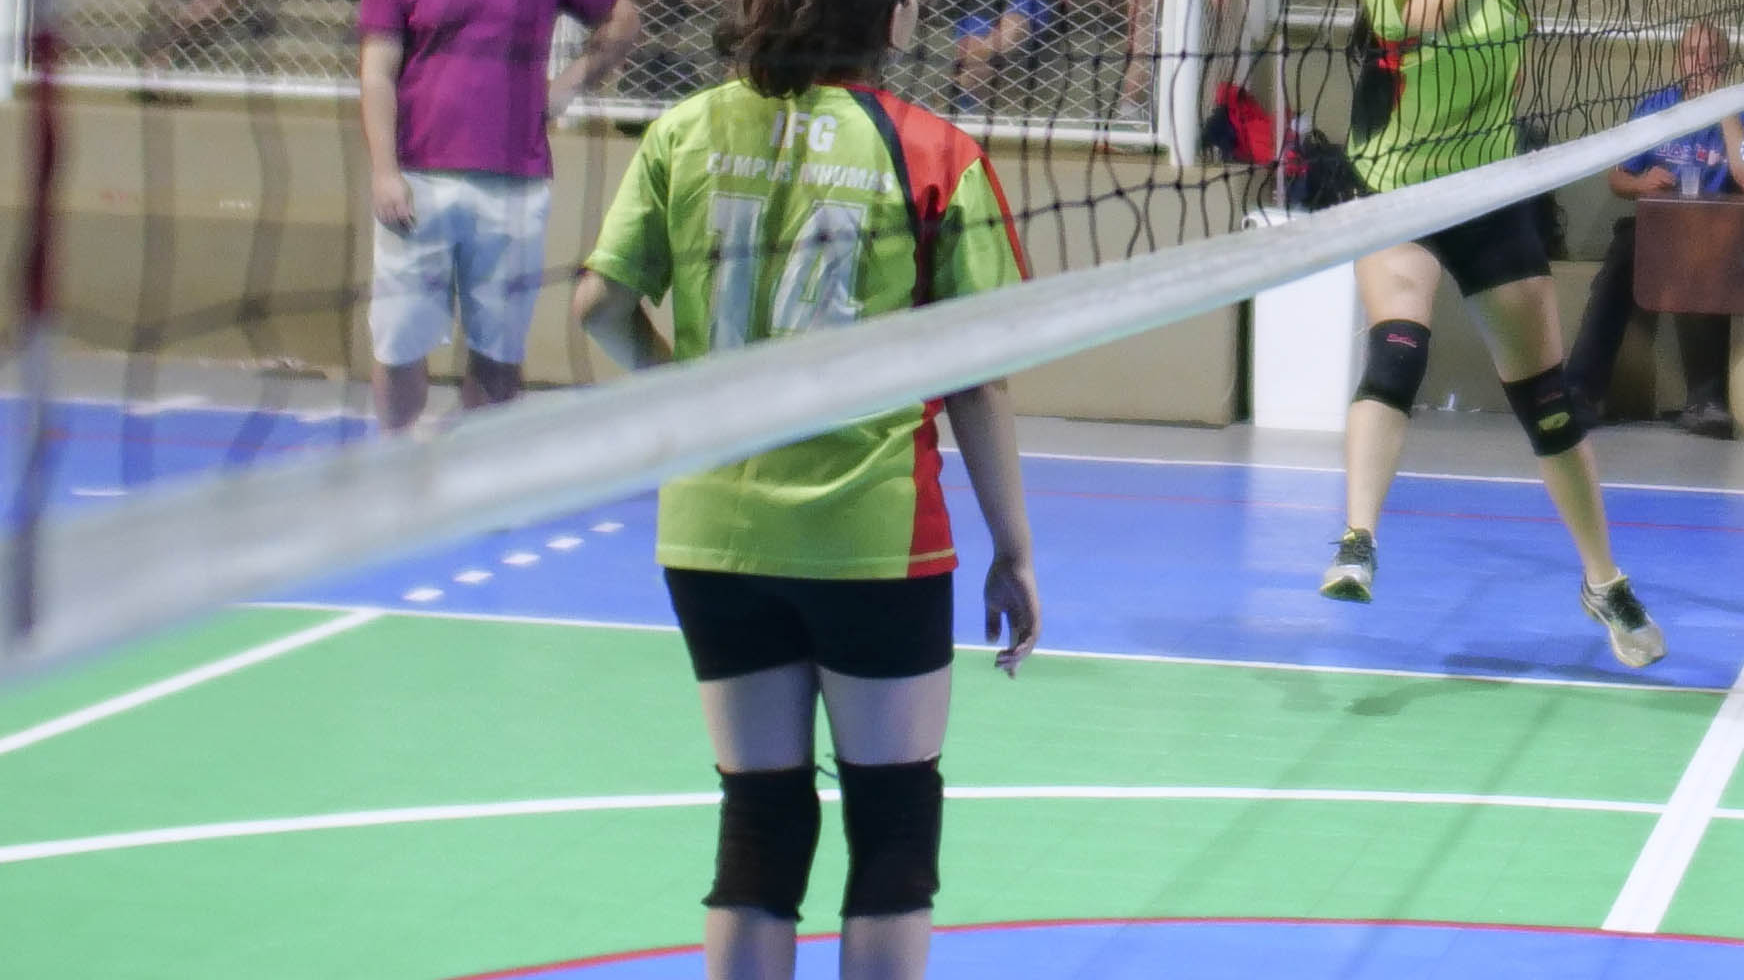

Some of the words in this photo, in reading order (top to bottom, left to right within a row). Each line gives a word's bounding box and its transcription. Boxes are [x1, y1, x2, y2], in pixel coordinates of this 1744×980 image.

[769, 110, 838, 153] IFG
[706, 151, 794, 183] CAMPUS
[799, 162, 895, 195] INHUMAS
[705, 192, 868, 350] 14
